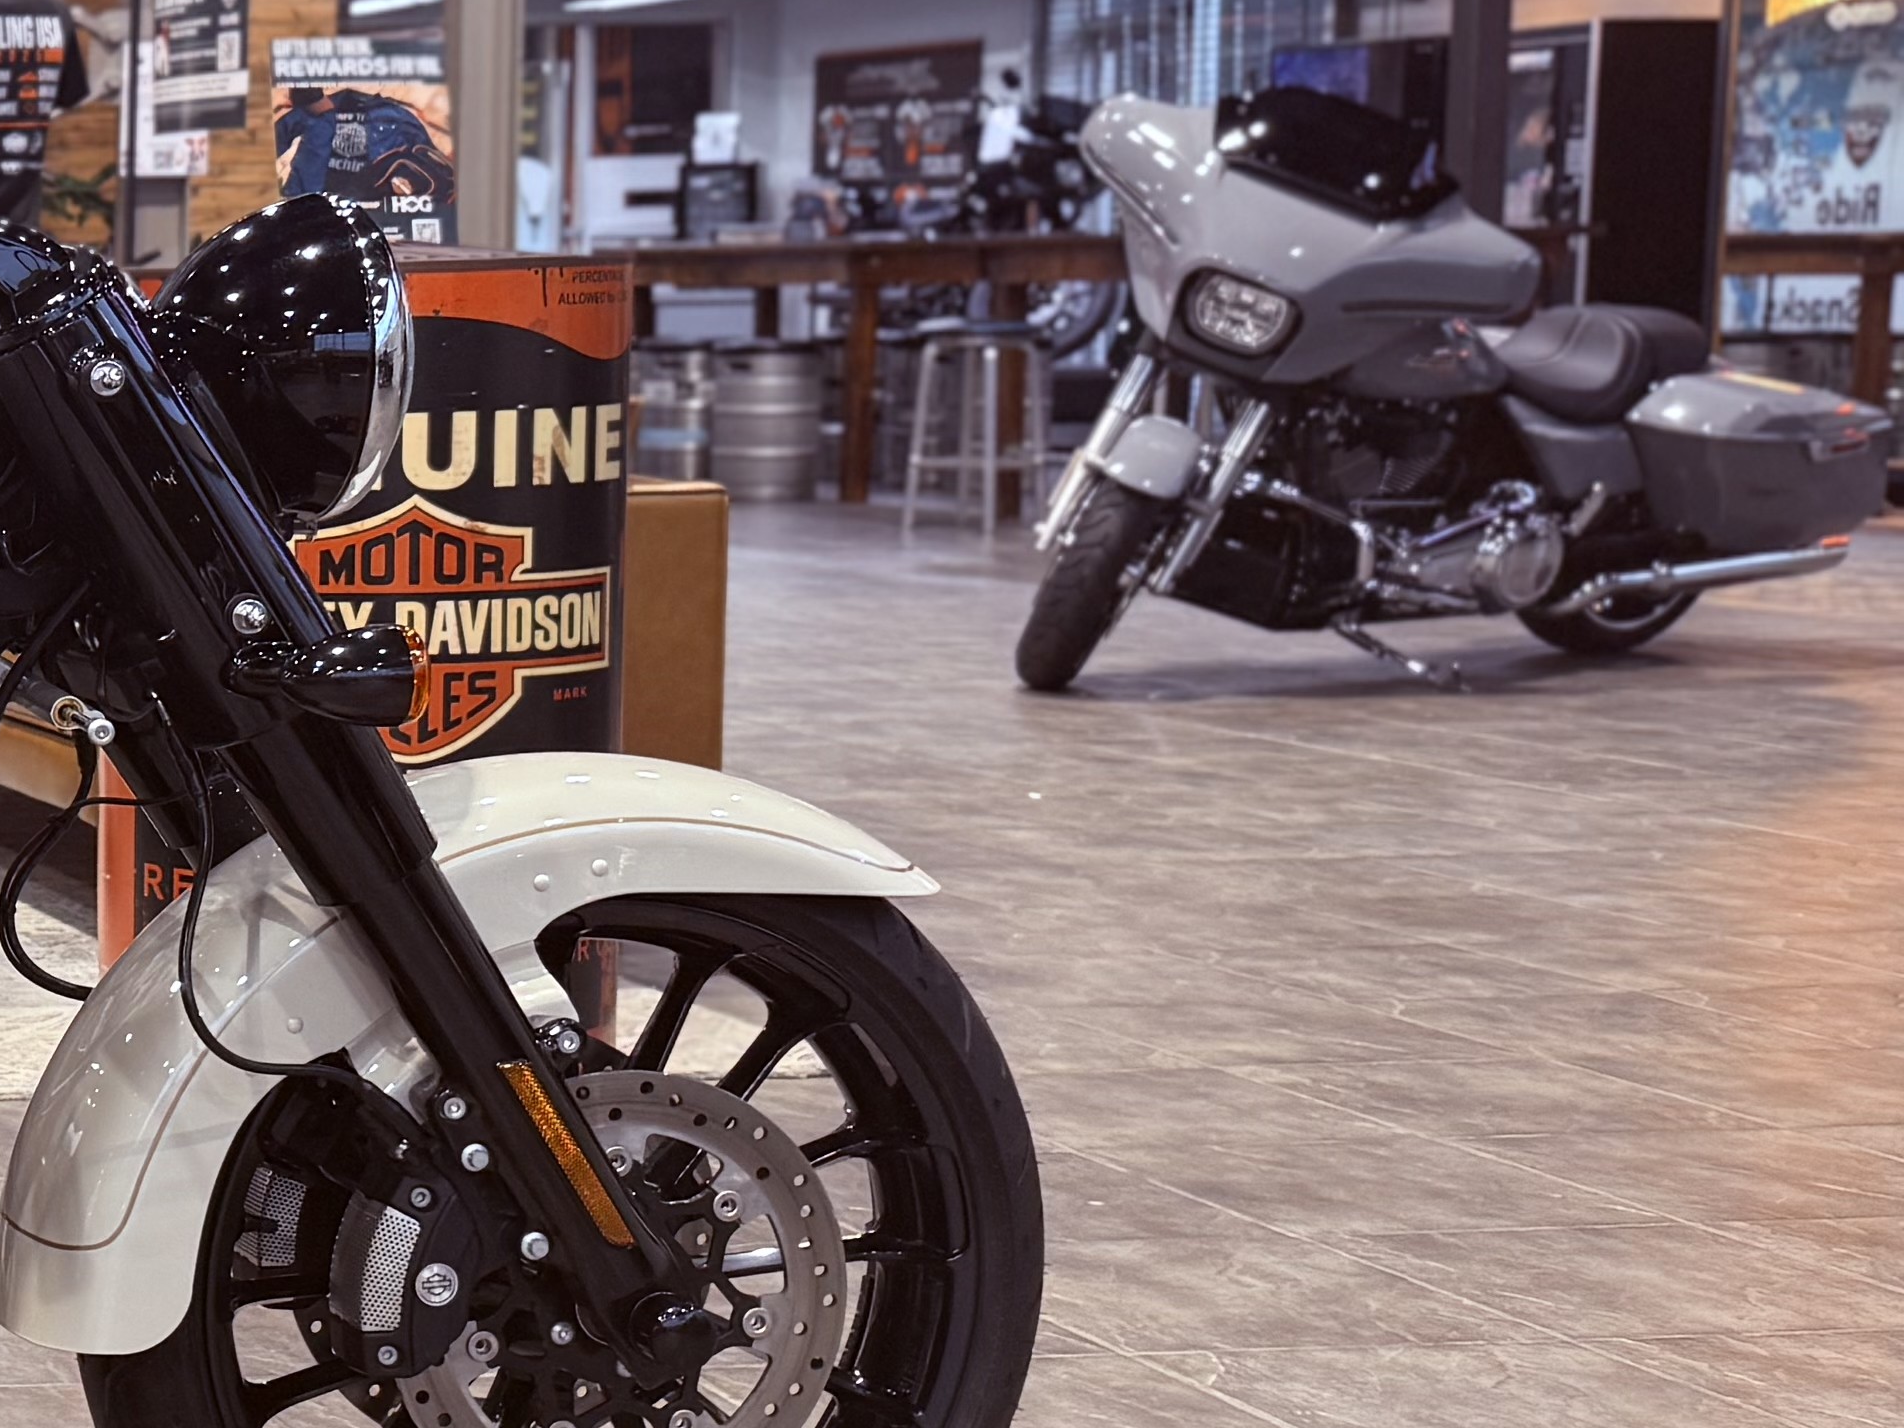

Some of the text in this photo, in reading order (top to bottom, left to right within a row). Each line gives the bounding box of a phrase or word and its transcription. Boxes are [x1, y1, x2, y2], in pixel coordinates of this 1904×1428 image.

[35, 15, 64, 49] USA
[275, 58, 388, 78] REWARDS
[372, 403, 622, 490] UINE
[319, 519, 504, 586] MOTOR
[553, 685, 587, 701] MARK
